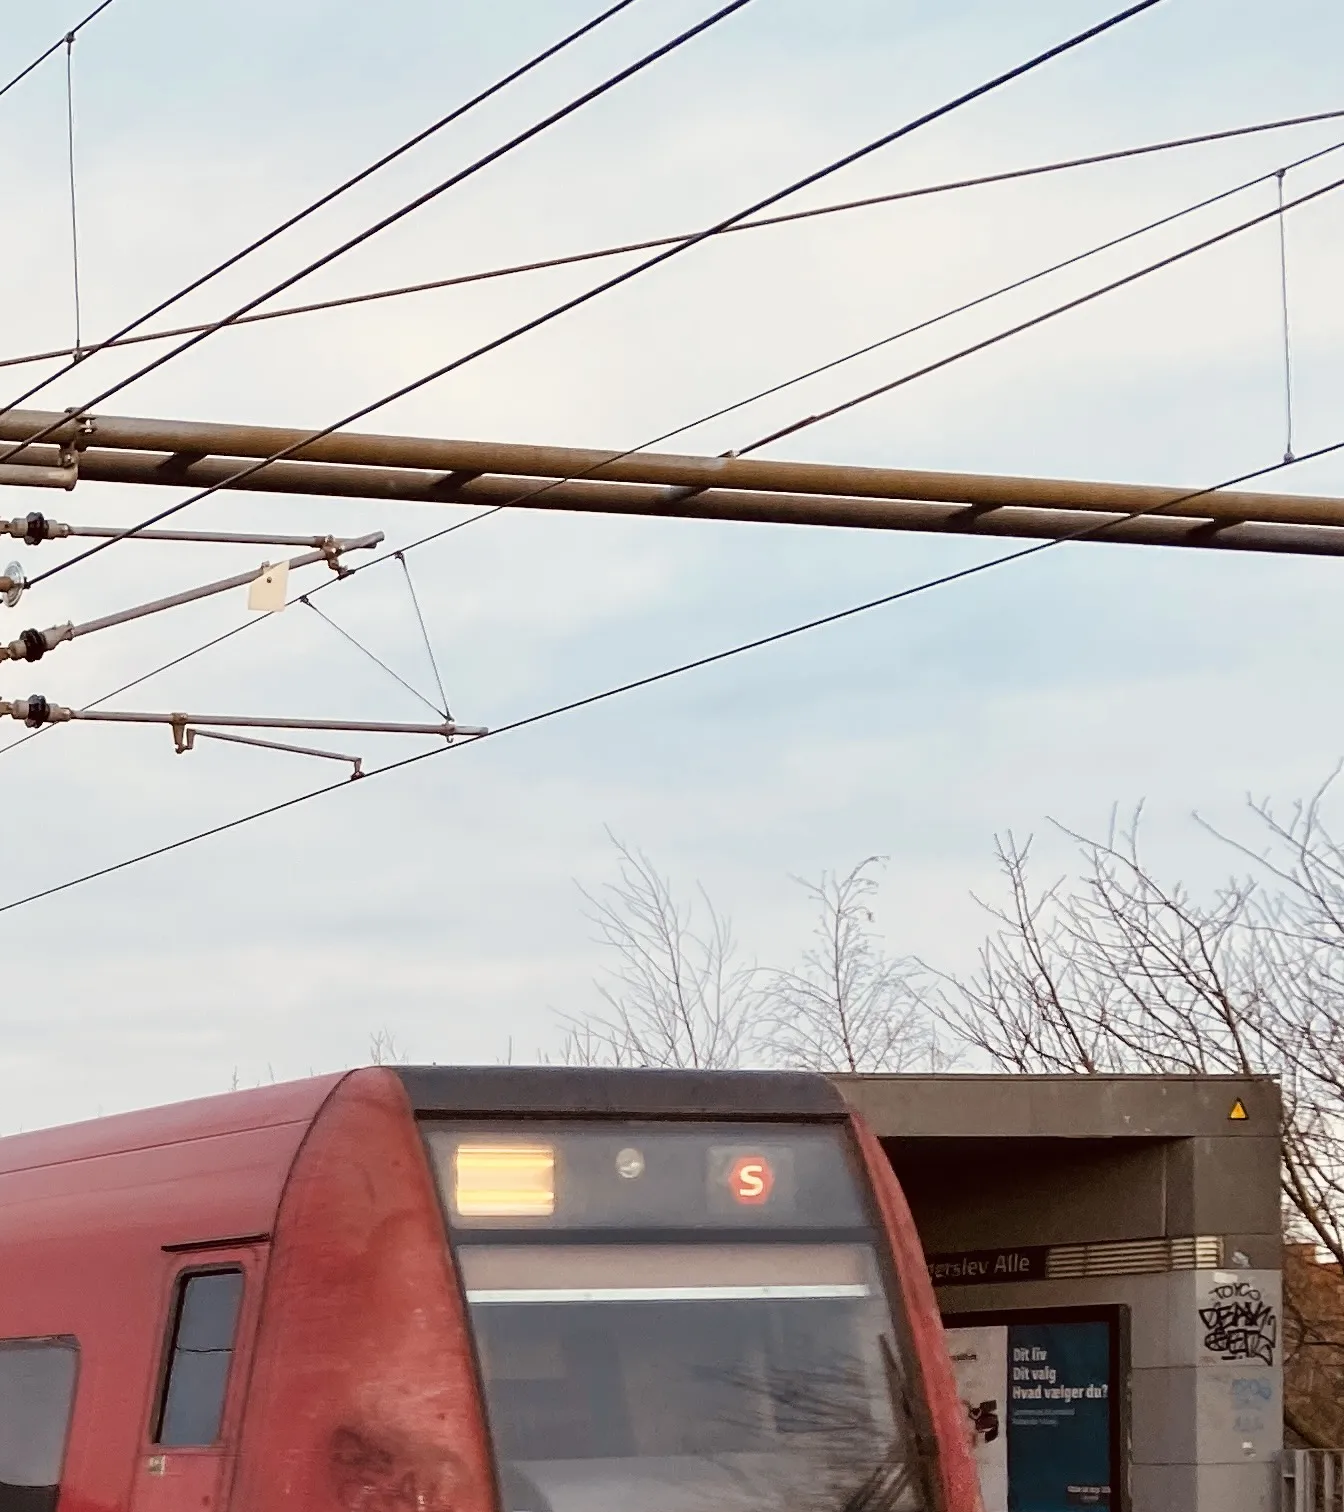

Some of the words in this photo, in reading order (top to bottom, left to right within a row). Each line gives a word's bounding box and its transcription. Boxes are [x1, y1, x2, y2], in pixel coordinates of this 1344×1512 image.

[739, 1164, 764, 1197] S
[1012, 1347, 1030, 1362] Dit
[1031, 1346, 1048, 1362] liv
[1012, 1366, 1030, 1381] Dit
[1031, 1365, 1057, 1384] valg
[1012, 1384, 1042, 1399] Hvad
[1085, 1383, 1109, 1399] du?
